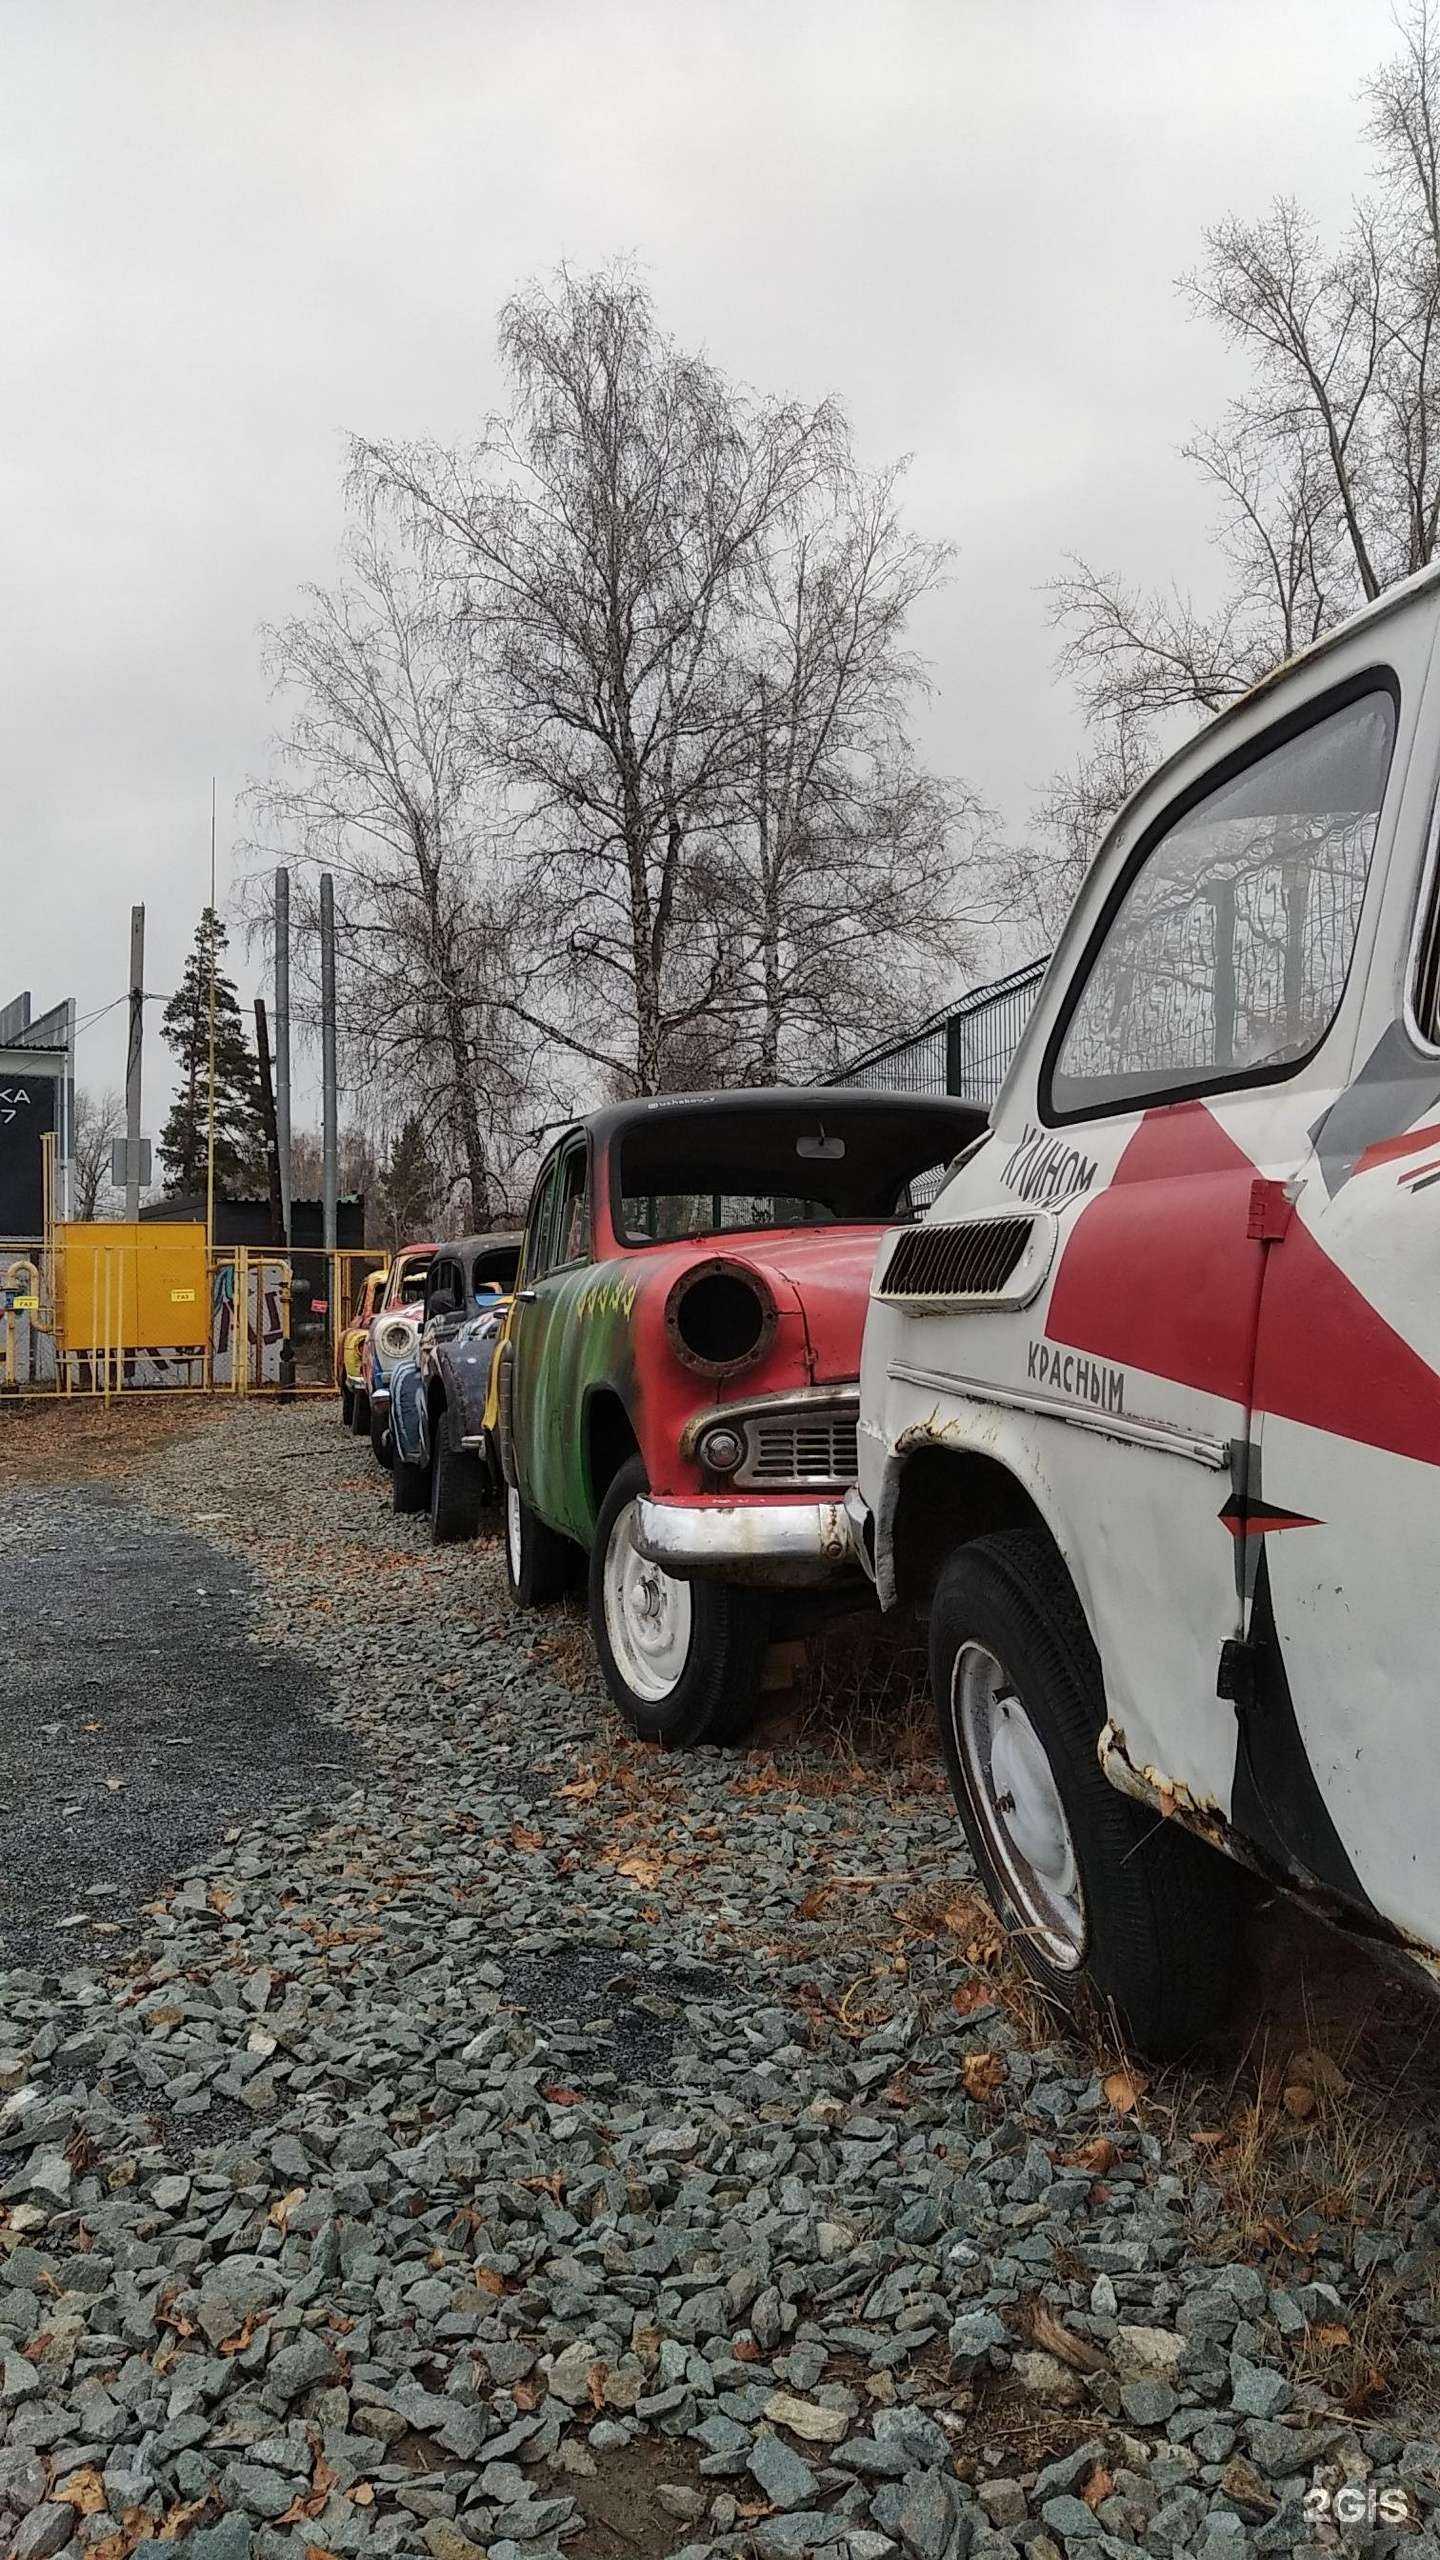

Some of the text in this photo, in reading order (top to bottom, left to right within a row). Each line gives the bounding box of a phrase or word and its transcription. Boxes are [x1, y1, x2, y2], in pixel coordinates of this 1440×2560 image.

[1, 1109, 16, 1124] 7
[1000, 1123, 1099, 1210] КЛИНОМ
[1027, 1340, 1125, 1414] КРАСНЫМ
